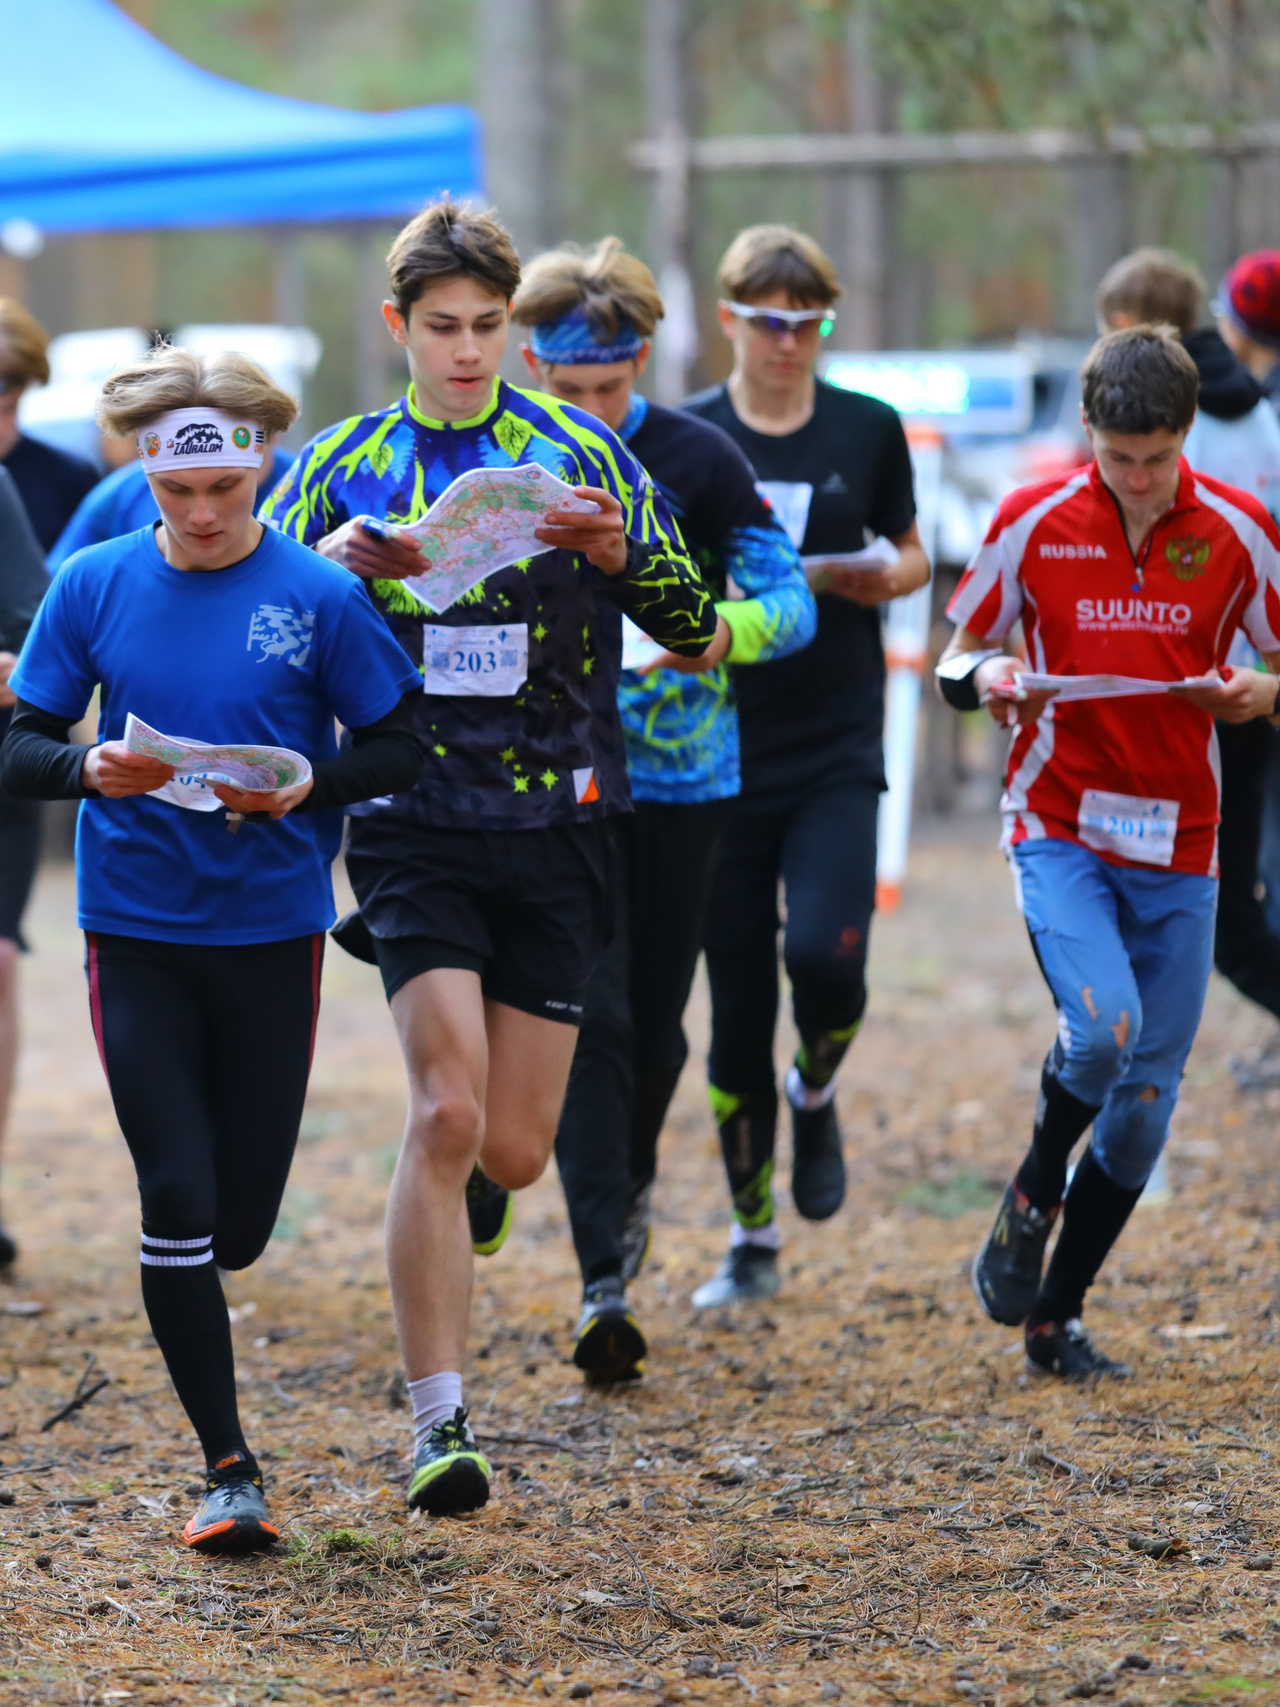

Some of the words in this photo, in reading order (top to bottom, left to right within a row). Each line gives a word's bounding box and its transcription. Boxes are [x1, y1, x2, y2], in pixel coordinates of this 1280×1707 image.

[173, 441, 223, 456] ZAURALOM
[1039, 544, 1108, 560] RUSSIA
[1075, 598, 1192, 626] SUUNTO
[453, 651, 497, 673] 203
[1108, 815, 1145, 839] 201
